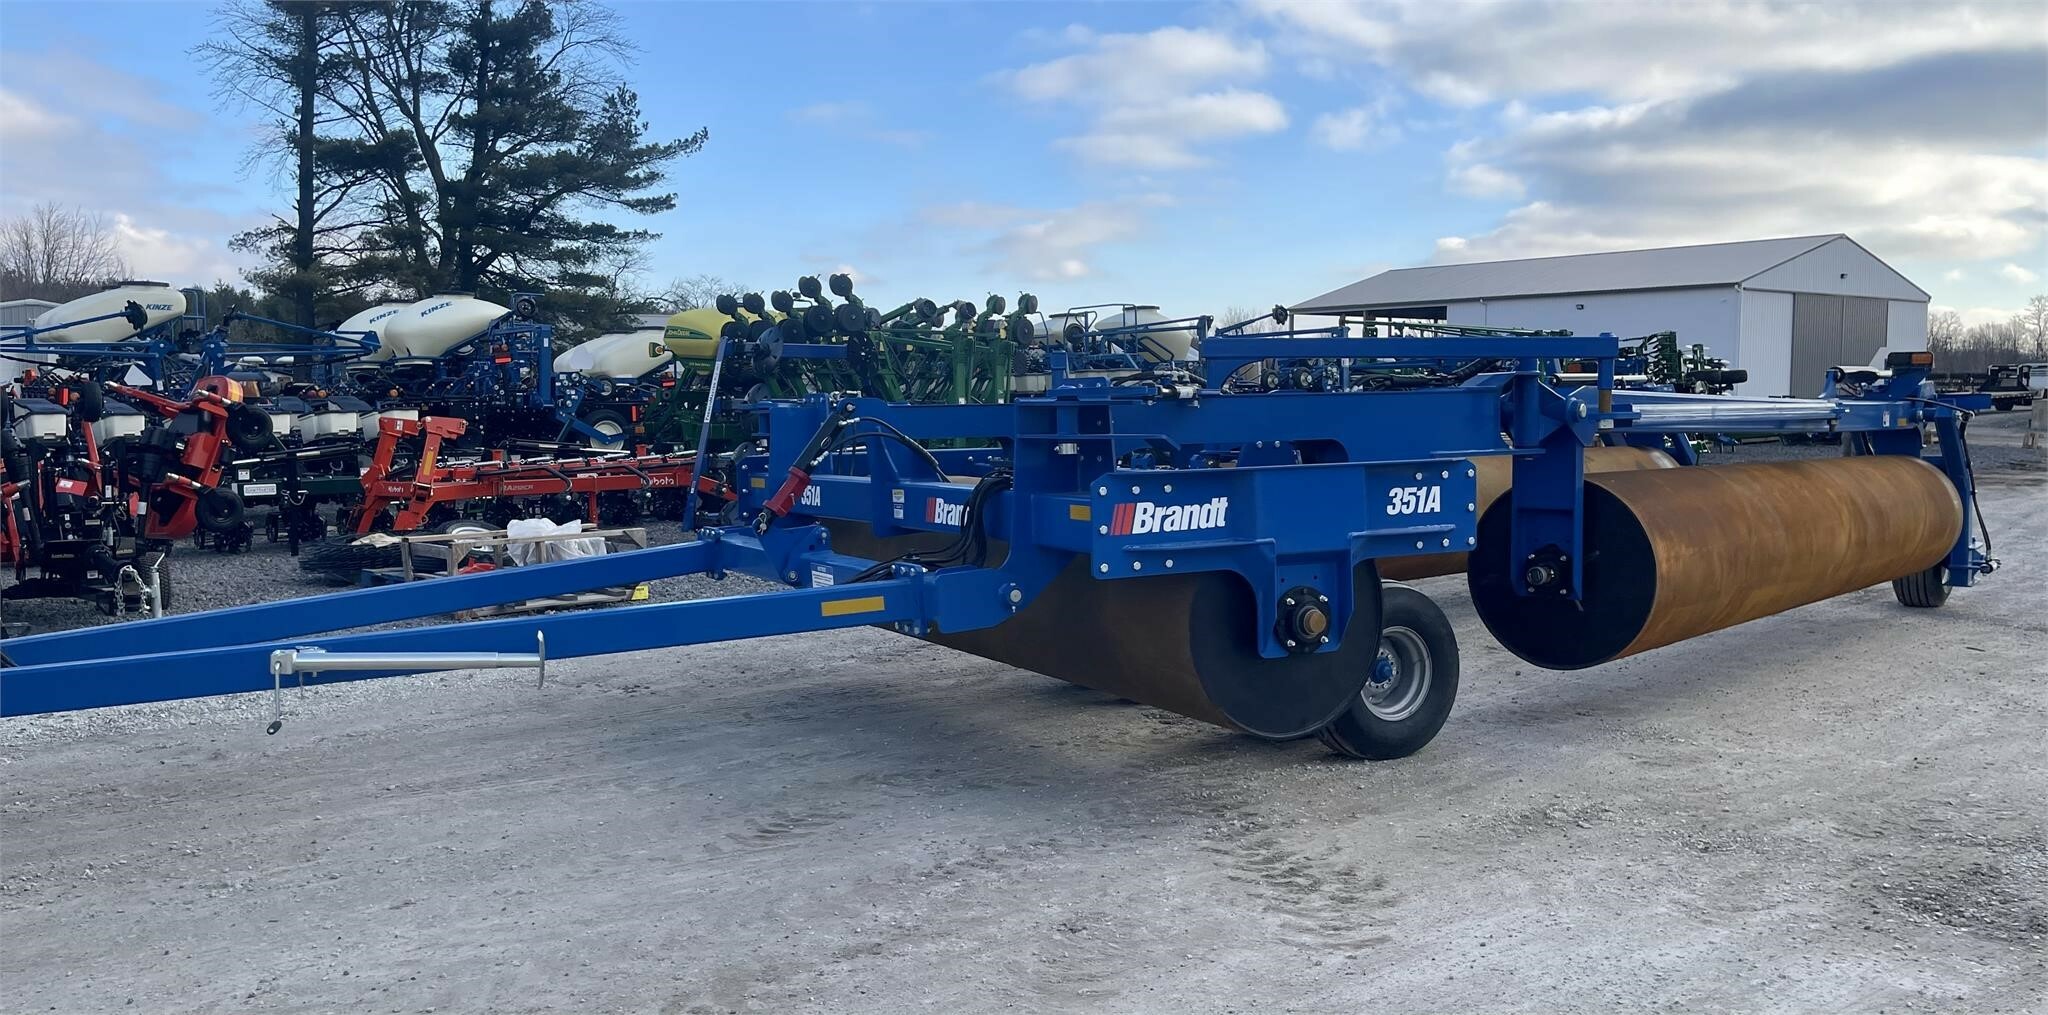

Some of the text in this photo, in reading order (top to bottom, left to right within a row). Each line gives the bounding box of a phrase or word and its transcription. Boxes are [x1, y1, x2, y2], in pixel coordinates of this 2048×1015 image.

[145, 303, 174, 311] KINZE
[369, 309, 400, 324] KINZE
[420, 301, 454, 318] KINZE
[801, 485, 821, 507] 351A
[1386, 485, 1441, 516] 351A
[1132, 497, 1228, 534] Brandt
